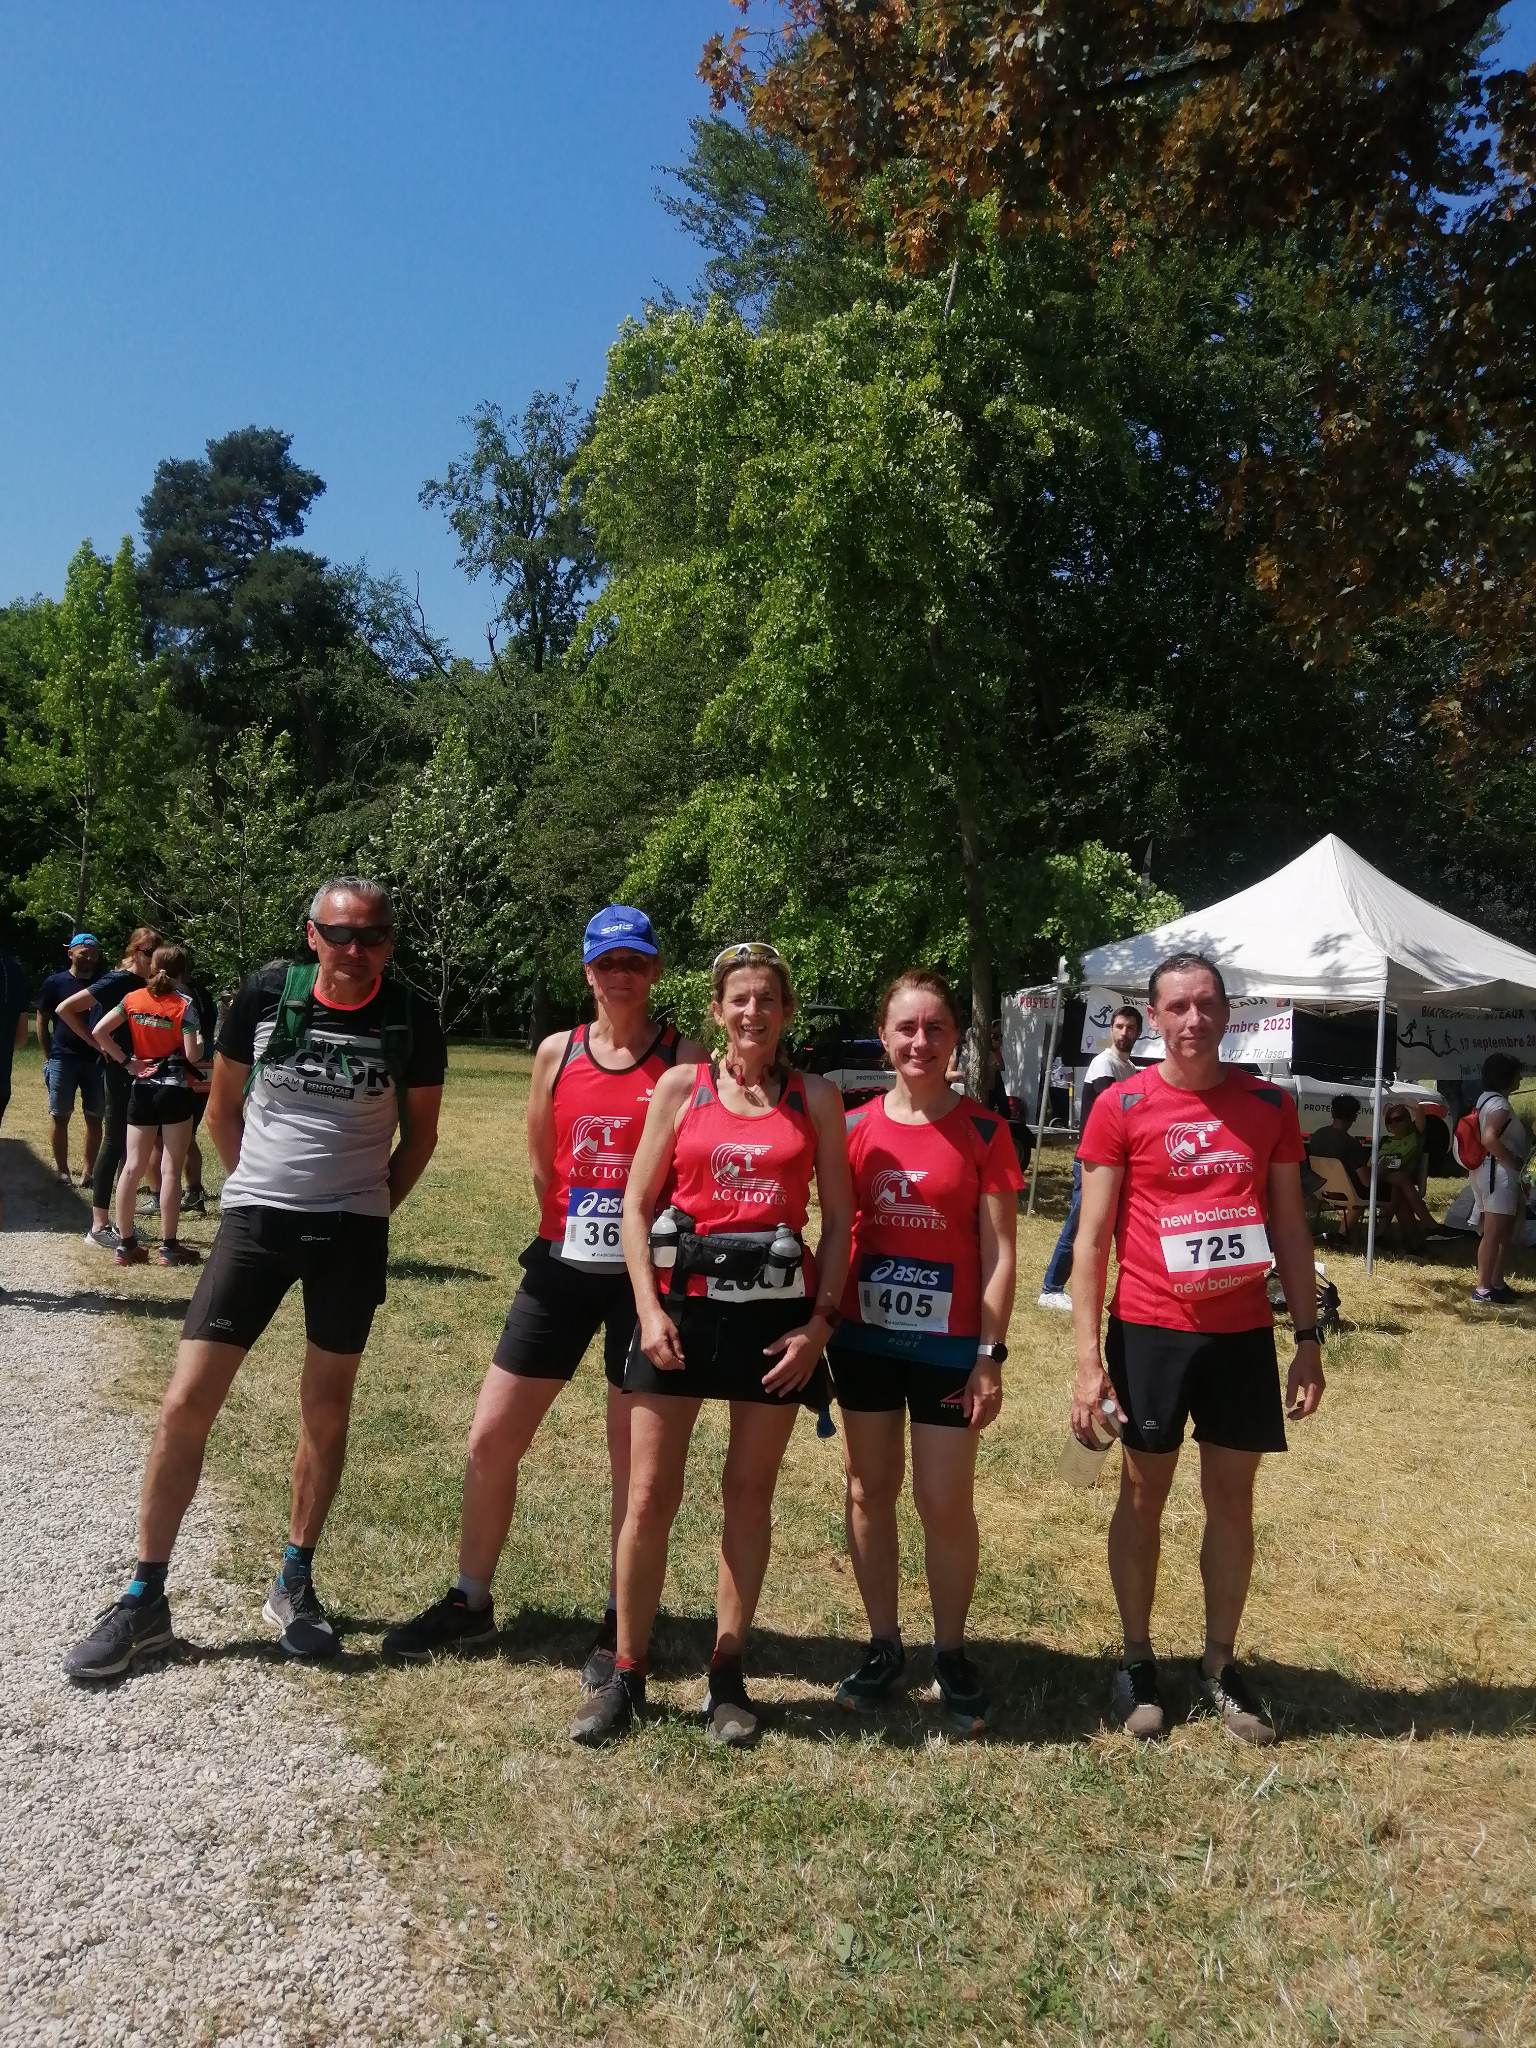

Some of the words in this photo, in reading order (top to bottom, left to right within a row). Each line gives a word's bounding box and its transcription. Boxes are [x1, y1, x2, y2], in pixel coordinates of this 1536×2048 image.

[1020, 996, 1049, 1009] POSTE
[1263, 1017, 1291, 1032] 2023
[263, 1070, 300, 1087] NITRAM
[568, 1165, 590, 1178] AC
[1168, 1166, 1190, 1178] AC
[1191, 1161, 1254, 1177] CLOYES
[711, 1189, 732, 1201] AC
[733, 1190, 787, 1206] CLOYES
[891, 1215, 948, 1231] CLOYES
[1160, 1211, 1193, 1229] new
[1193, 1204, 1257, 1224] balance
[584, 1221, 621, 1248] 36
[1185, 1233, 1246, 1265] 725
[892, 1265, 940, 1286] asics
[1173, 1281, 1206, 1294] new
[878, 1288, 934, 1318] 405
